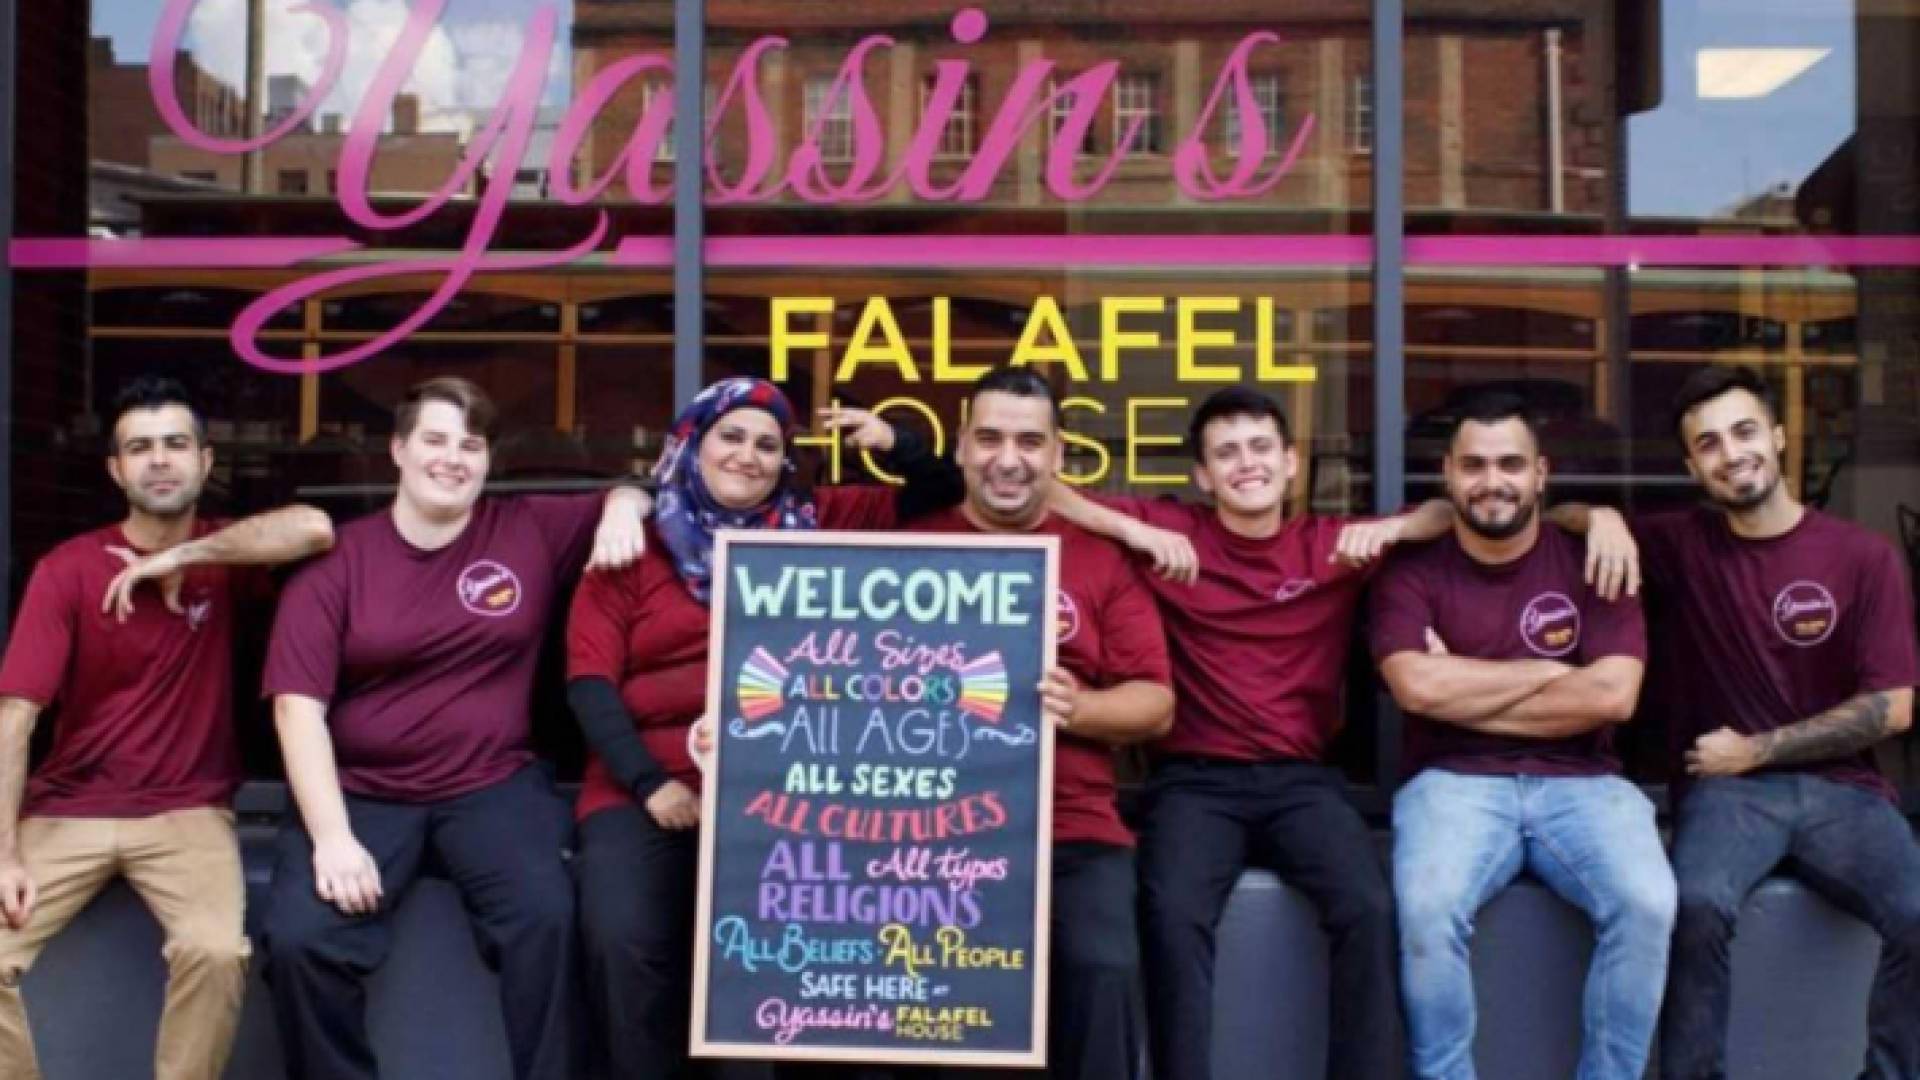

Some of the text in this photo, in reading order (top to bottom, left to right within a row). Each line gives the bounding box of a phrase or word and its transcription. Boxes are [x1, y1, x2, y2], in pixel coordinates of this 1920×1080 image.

[769, 296, 1317, 382] FALAFEL
[793, 397, 1189, 484] HOSE
[735, 564, 1032, 625] WELCOME
[784, 629, 967, 674] All Sizes
[789, 674, 955, 704] ALL COLORS
[855, 706, 970, 759] AGES
[785, 761, 957, 800] ALL SEXES
[745, 791, 1007, 842] ALL CULTURES
[761, 840, 850, 881] ALL
[866, 847, 931, 880] All
[758, 882, 983, 928] RELIGIONS
[777, 923, 873, 972] BELIEFS
[936, 924, 1025, 970] PEOPLE
[800, 971, 857, 998] SAFE
[865, 974, 927, 1000] HERE
[895, 1007, 993, 1026] FALAFEL
[895, 1023, 965, 1041] HOUSE
